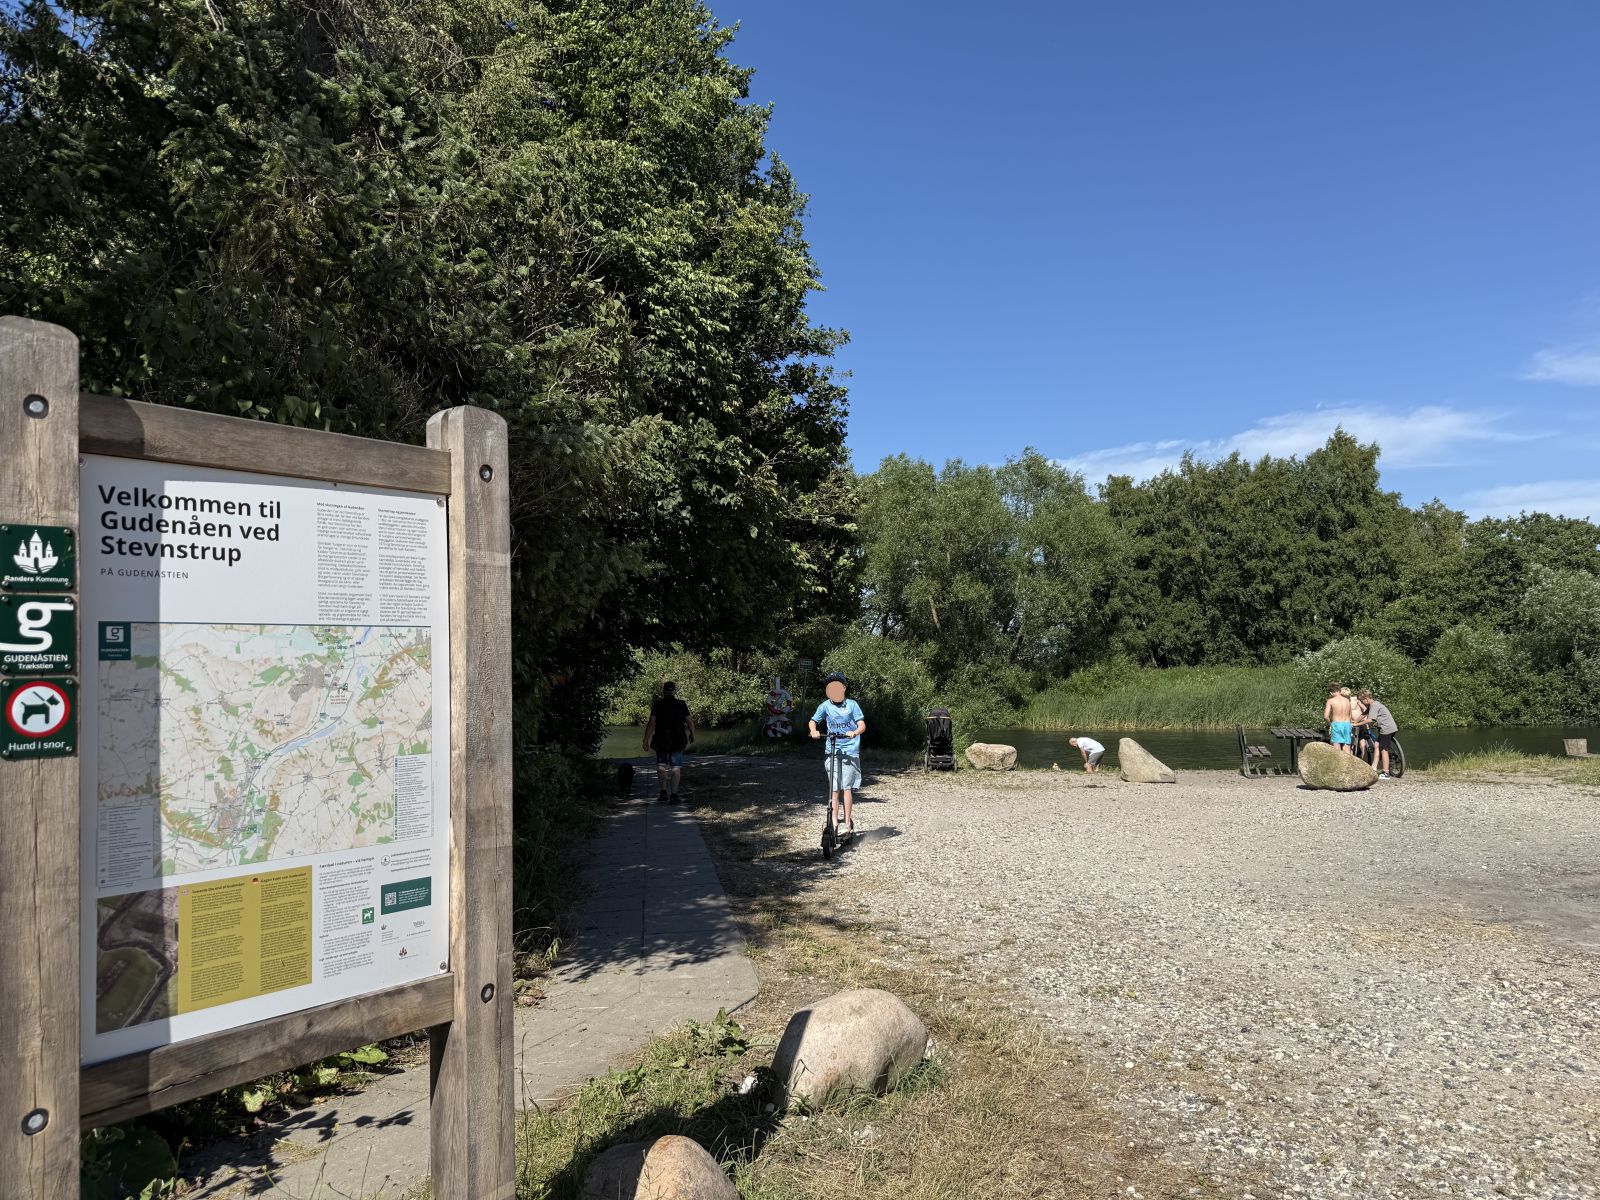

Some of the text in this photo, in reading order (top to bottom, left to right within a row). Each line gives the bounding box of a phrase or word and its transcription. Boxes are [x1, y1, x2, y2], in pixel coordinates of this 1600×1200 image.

[98, 485, 281, 519] Velkommen til
[101, 511, 280, 541] Gudenåen ved
[101, 536, 241, 566] Stevnstrup
[101, 568, 189, 579] PÅ GUDENÅSTIEN
[4, 653, 68, 663] GUDENÅSTIEN
[8, 741, 65, 751] Hund i snor
